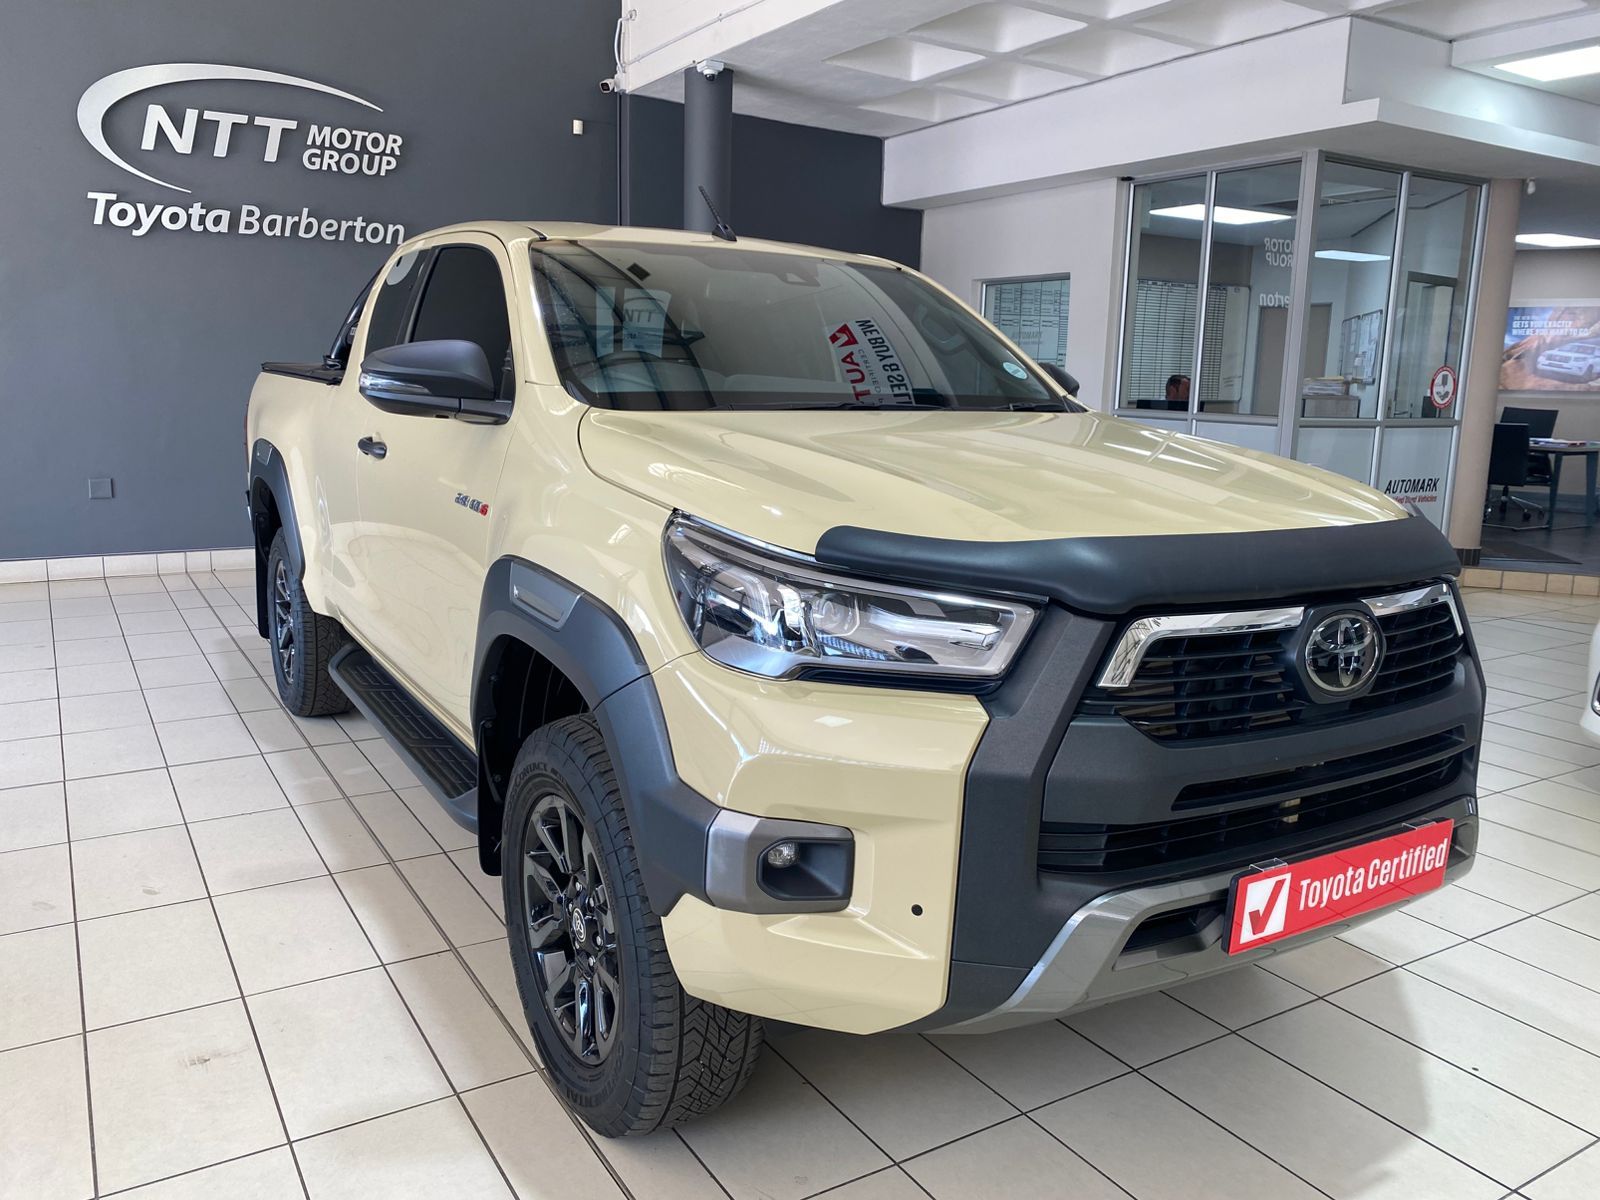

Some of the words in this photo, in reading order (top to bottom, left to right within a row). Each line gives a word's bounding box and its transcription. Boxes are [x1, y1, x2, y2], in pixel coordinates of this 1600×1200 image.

[140, 103, 298, 162] NTT
[306, 124, 403, 156] MOTOR
[302, 148, 397, 176] GROUP
[87, 191, 231, 237] Toyota
[238, 204, 406, 245] Barberton
[1384, 478, 1439, 494] AUTOMARK
[1299, 866, 1365, 911] Toyota
[1367, 838, 1449, 890] Certified
